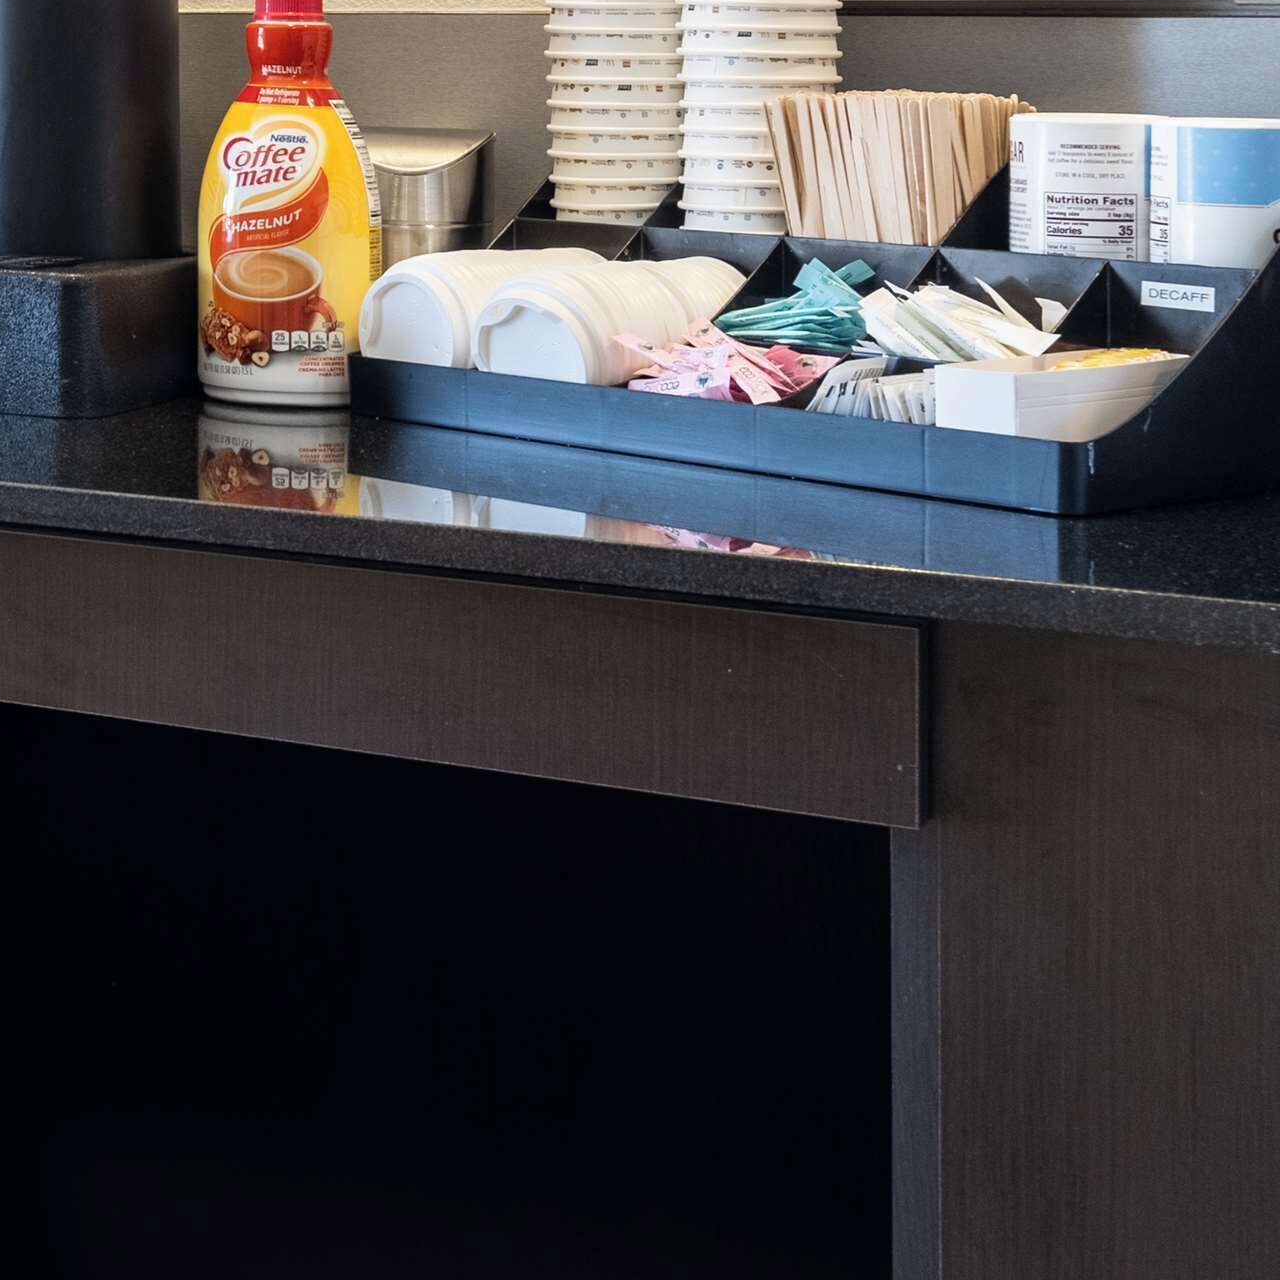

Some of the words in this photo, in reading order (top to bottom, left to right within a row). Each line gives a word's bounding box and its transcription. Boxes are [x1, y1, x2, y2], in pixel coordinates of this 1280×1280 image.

[261, 64, 302, 75] HAZELNUT
[223, 136, 306, 170] Coffee
[235, 165, 297, 188] mate
[1046, 195, 1099, 205] Nutrition
[1102, 196, 1135, 206] Facts
[231, 208, 303, 233] HAZELNUT
[1046, 225, 1083, 235] Calories
[1118, 225, 1134, 236] 35
[1148, 287, 1209, 302] DECAFF
[274, 332, 286, 341] 25
